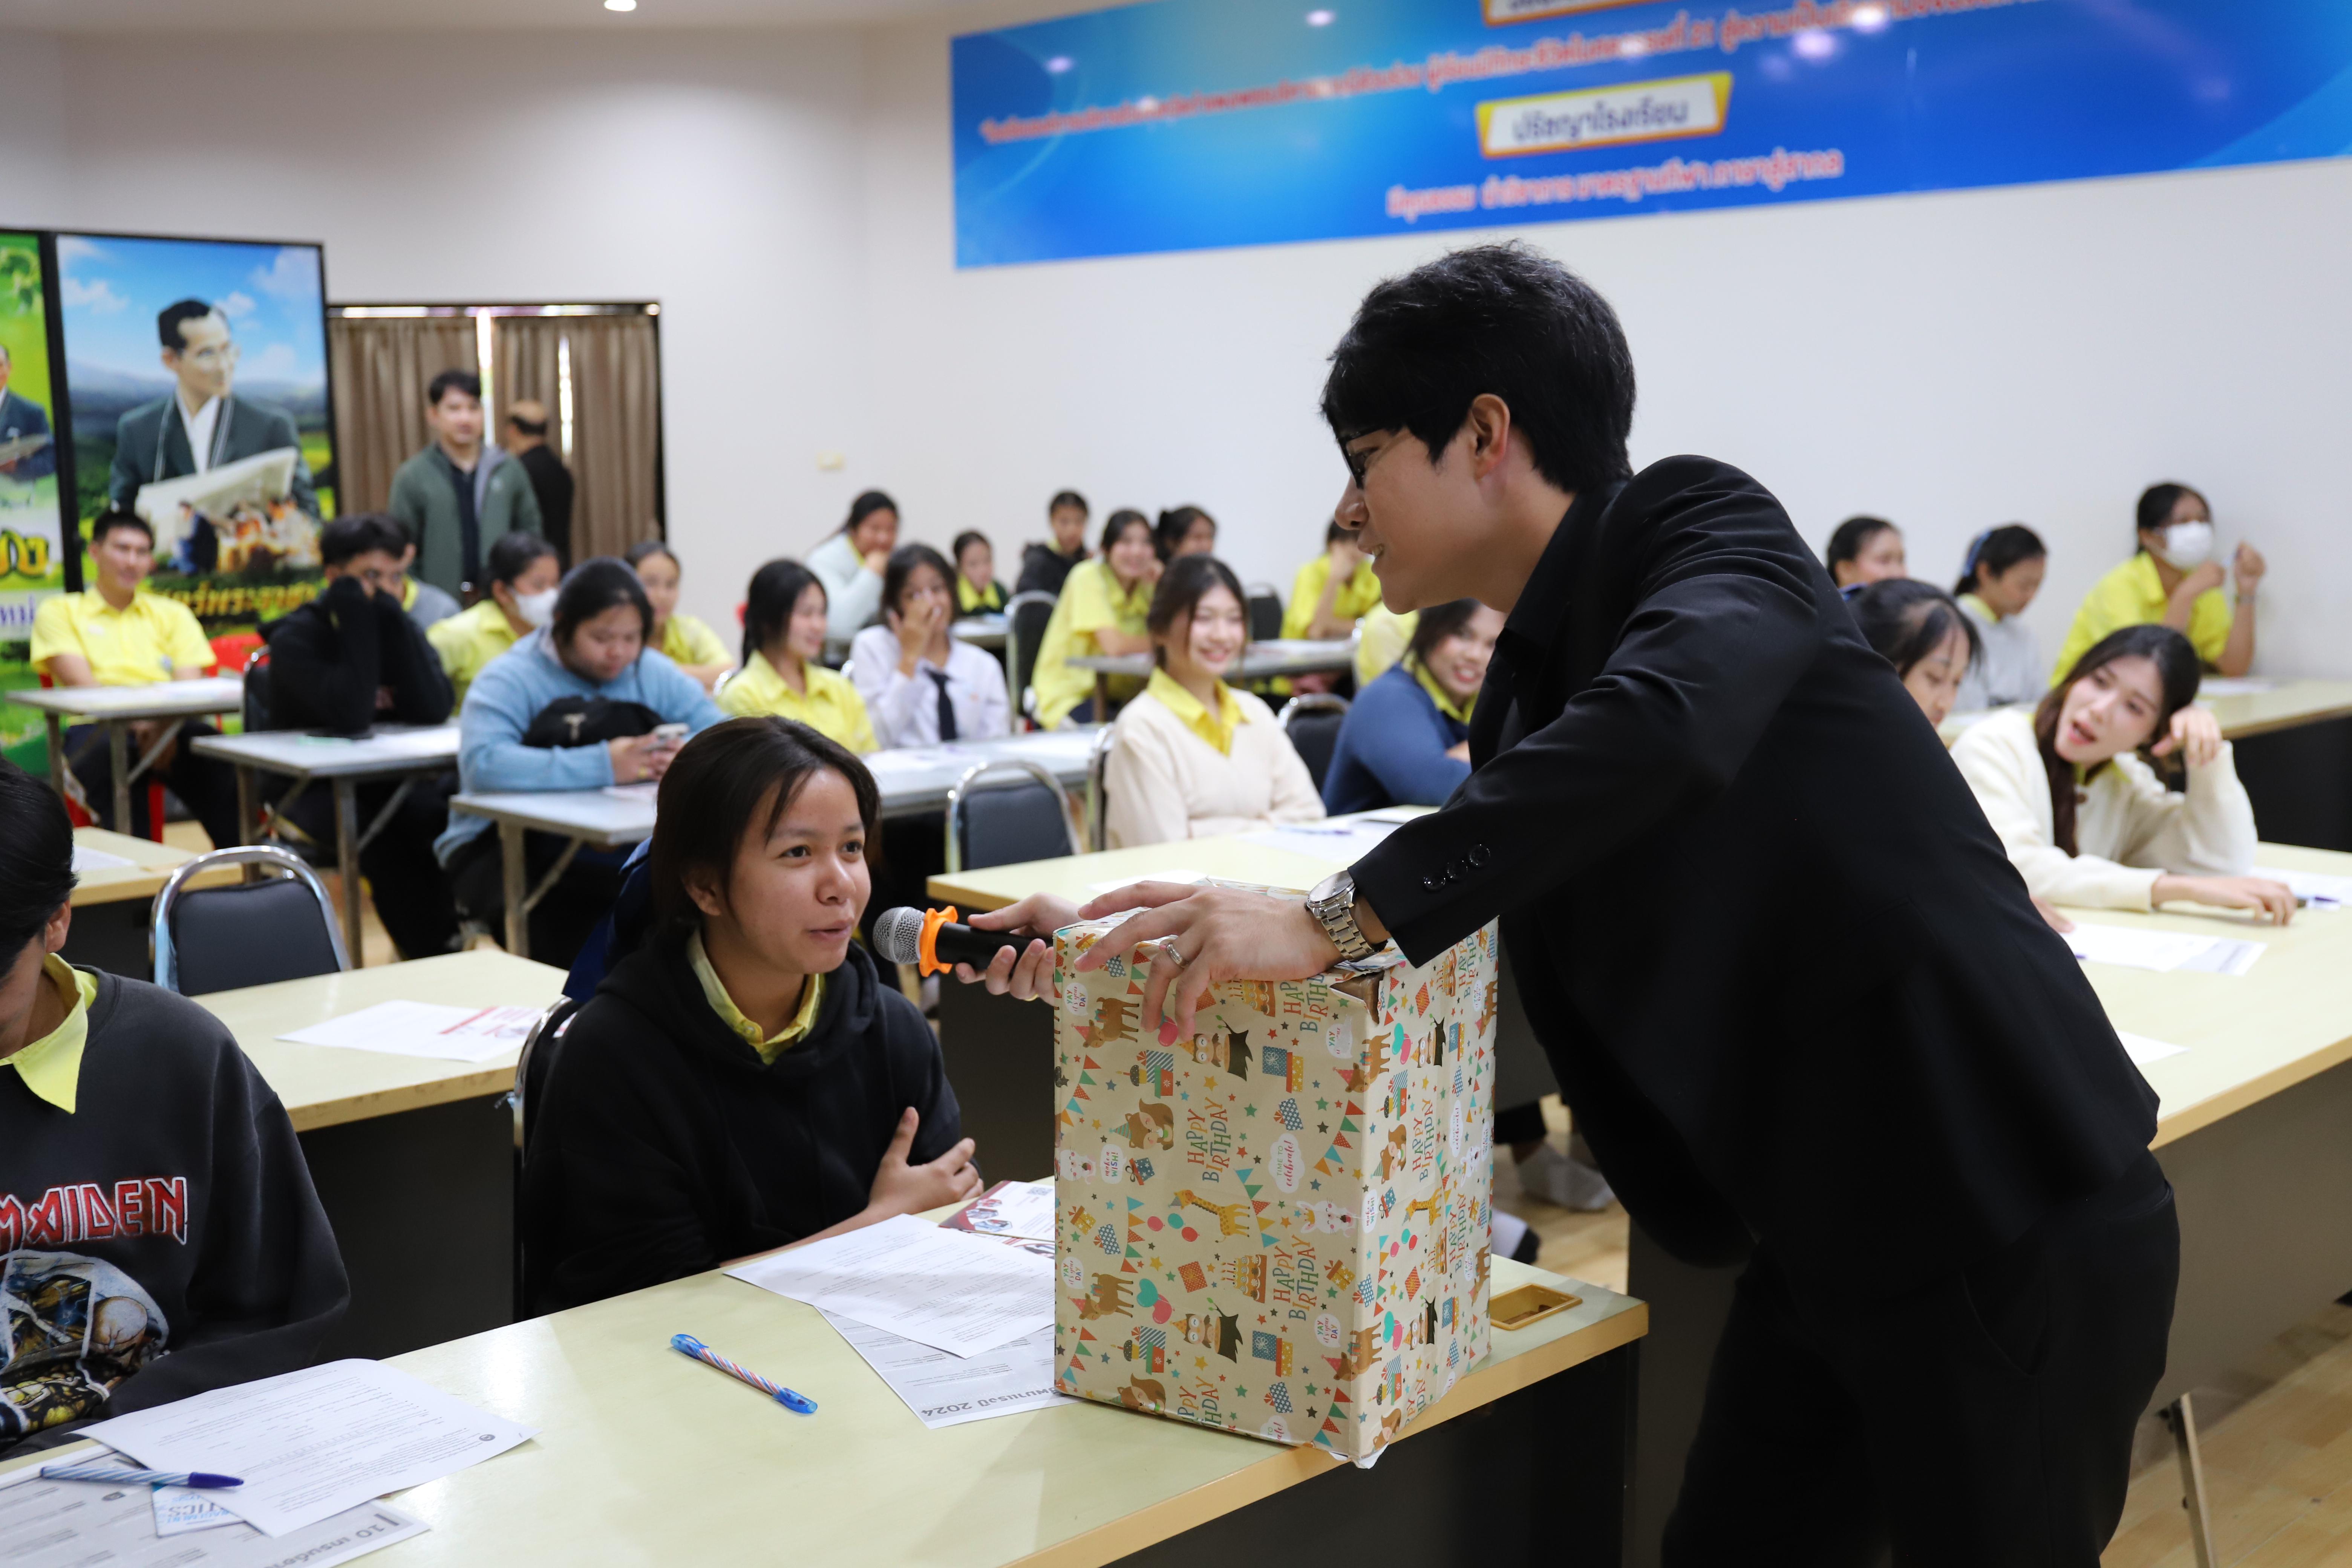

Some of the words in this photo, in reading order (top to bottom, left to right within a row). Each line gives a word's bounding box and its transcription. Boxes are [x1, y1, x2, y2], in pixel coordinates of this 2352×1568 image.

[1458, 941, 1467, 988] HAPP
[1464, 935, 1476, 999] BIRTHD
[1280, 980, 1305, 1015] HAP
[1300, 974, 1329, 1033] BIRTHD
[1110, 1152, 1119, 1177] WISH!
[1186, 1109, 1208, 1165] HAPPY
[1202, 1097, 1231, 1183] BIRTHDAY
[1278, 1145, 1283, 1155] TO
[1283, 1140, 1294, 1186] celebrate!
[1412, 1117, 1423, 1172] HAPPY
[1419, 1098, 1434, 1182] BIRTHDAY
[1449, 1211, 1457, 1263] HAPPY
[1455, 1193, 1466, 1273] BIRTHDAY
[1272, 1245, 1295, 1303] HAPPY
[1288, 1234, 1318, 1321] BIRTHDAY
[920, 1402, 972, 1416] 2024
[355, 1524, 385, 1539] 10
